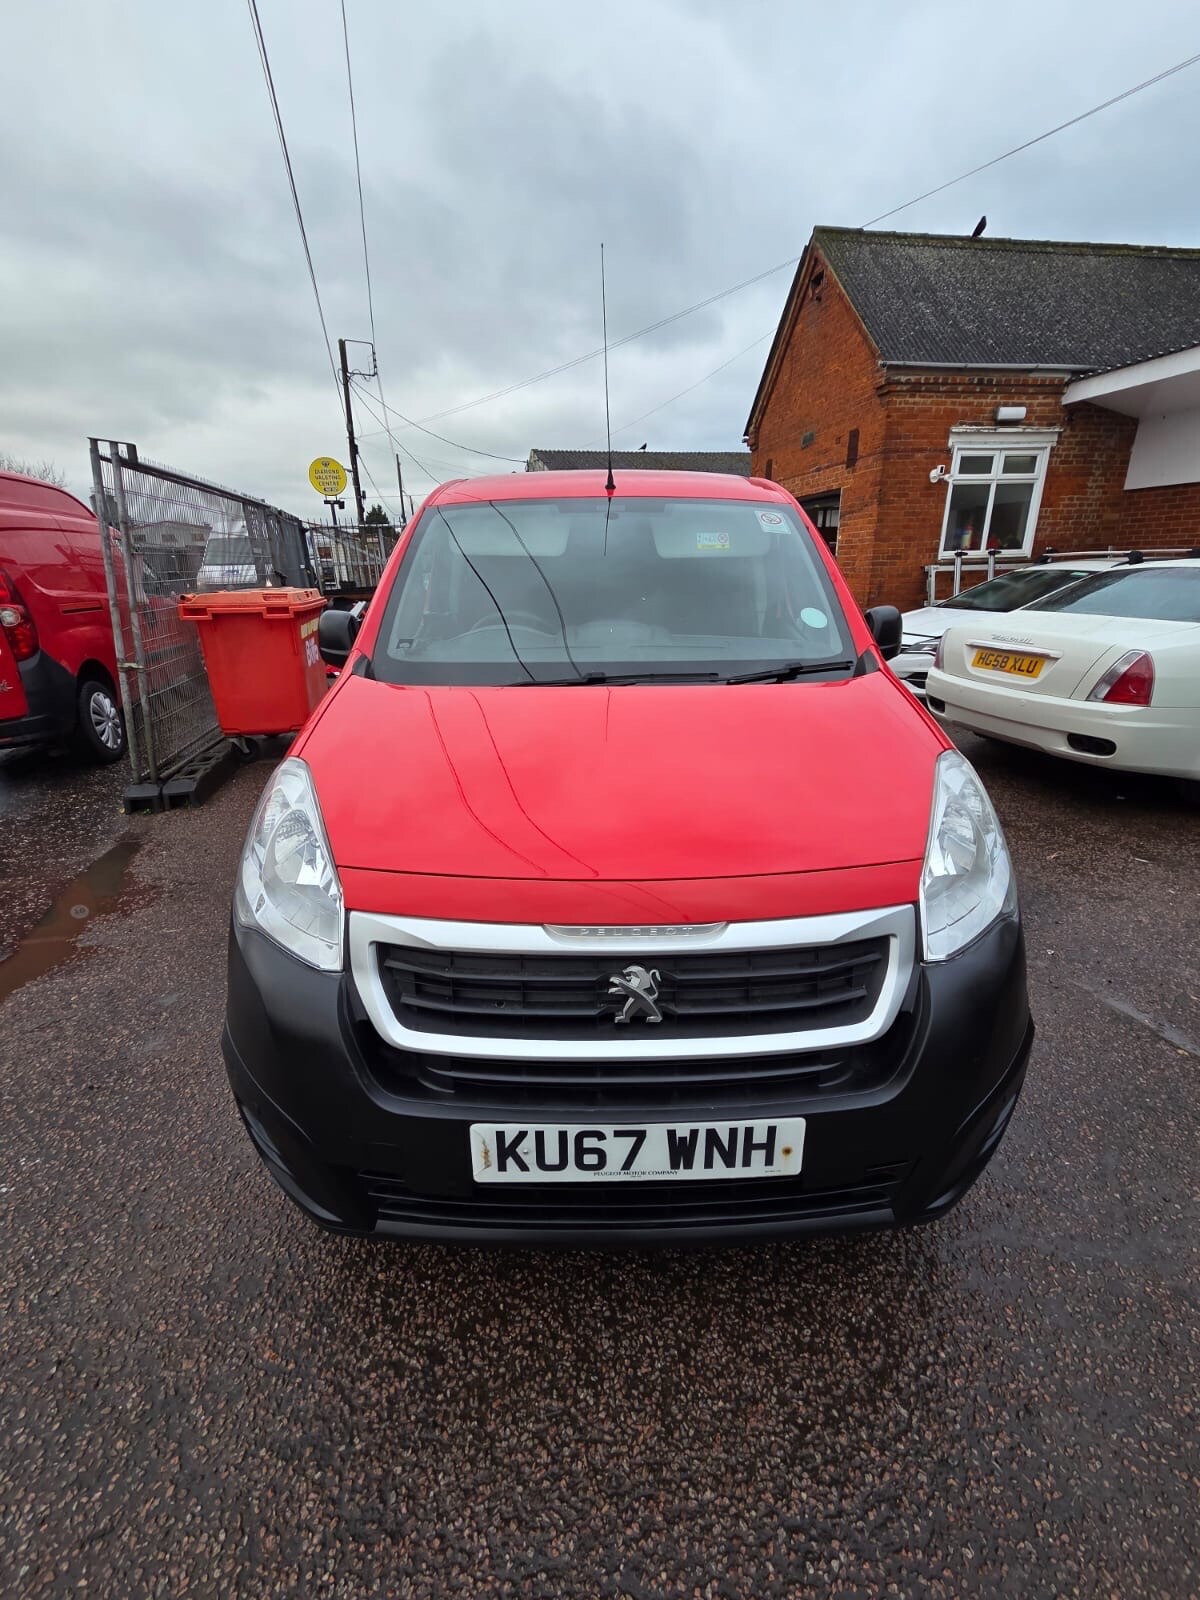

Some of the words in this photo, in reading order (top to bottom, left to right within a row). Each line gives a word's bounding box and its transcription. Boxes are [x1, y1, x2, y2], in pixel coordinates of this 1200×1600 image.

[976, 651, 1010, 669] HG58
[1009, 656, 1039, 674] XLU
[579, 927, 693, 936] PEUGEOT
[495, 1129, 647, 1172] KU67
[666, 1125, 778, 1170] WNH
